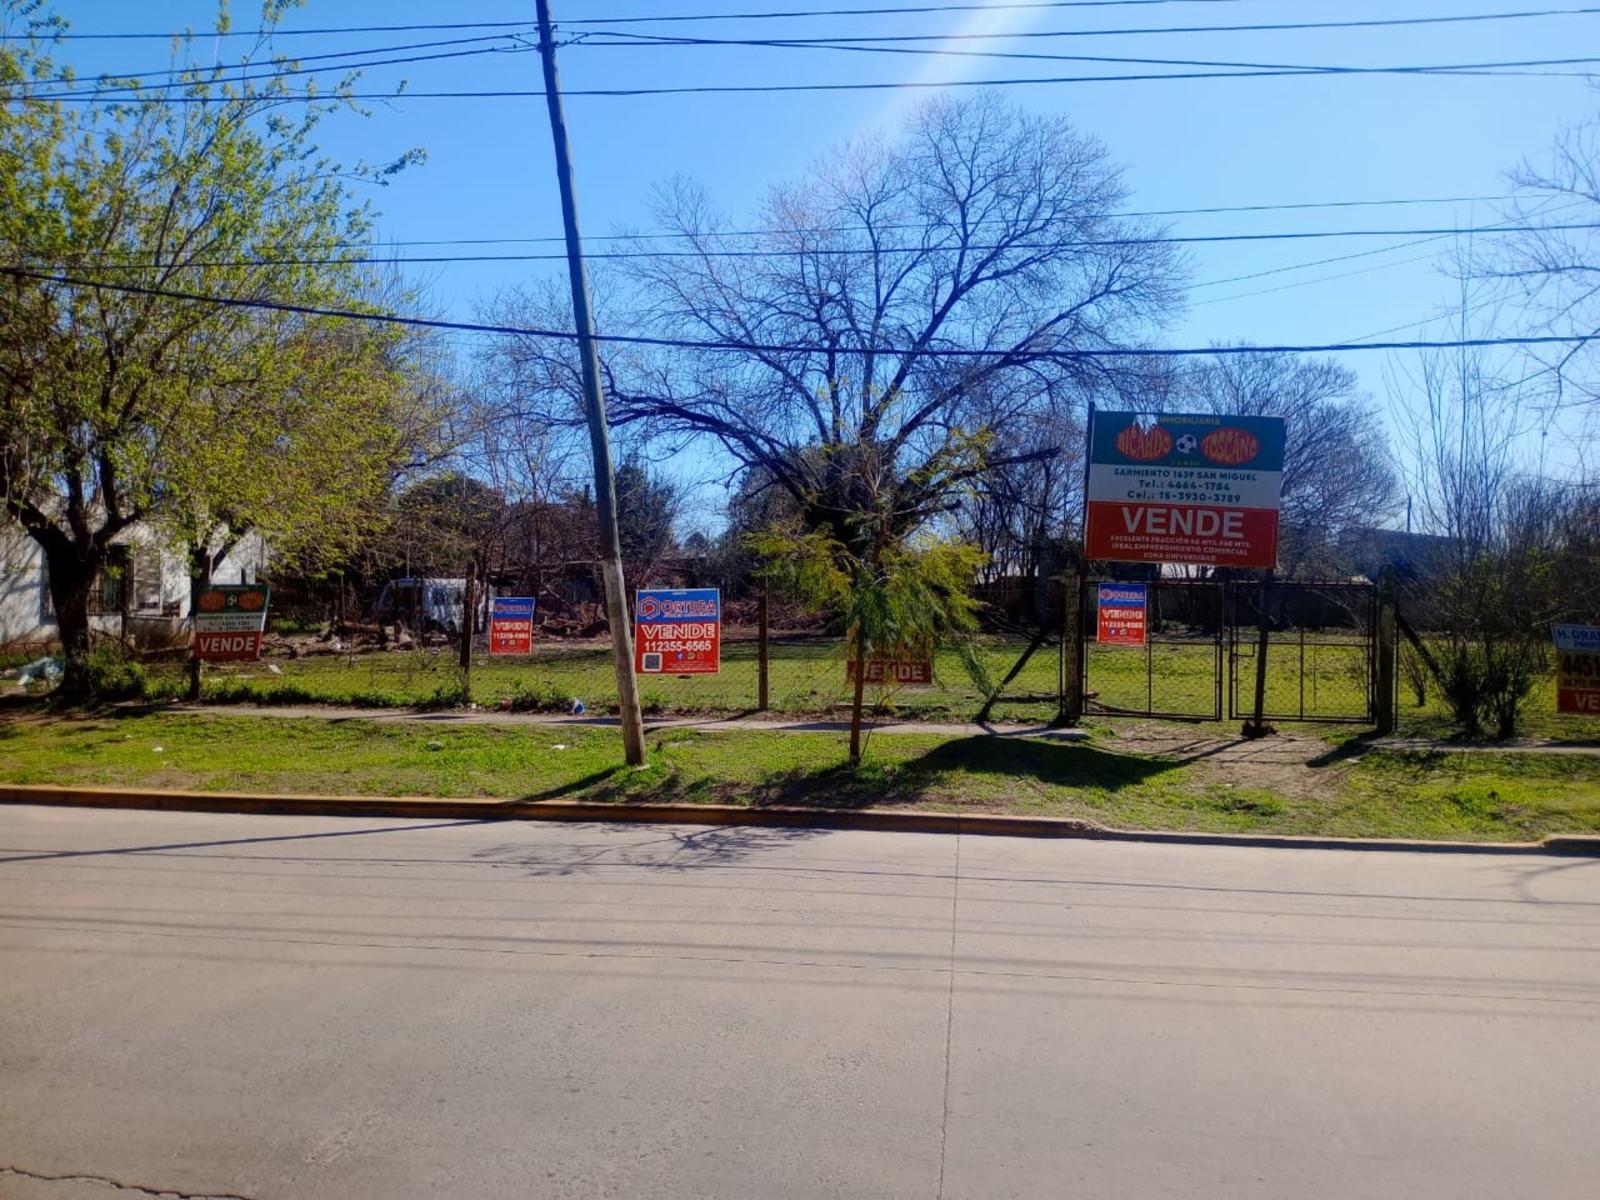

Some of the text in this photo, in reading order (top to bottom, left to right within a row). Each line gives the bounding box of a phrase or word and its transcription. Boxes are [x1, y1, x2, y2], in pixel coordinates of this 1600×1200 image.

[1113, 468, 1170, 478] SARMIENTO
[1197, 471, 1217, 480] SAN
[1219, 472, 1257, 481] MIGUEL
[1121, 506, 1245, 538] VENDE
[660, 599, 717, 613] ORTEGA
[641, 623, 716, 640] VENDE
[199, 637, 256, 652] VENDE
